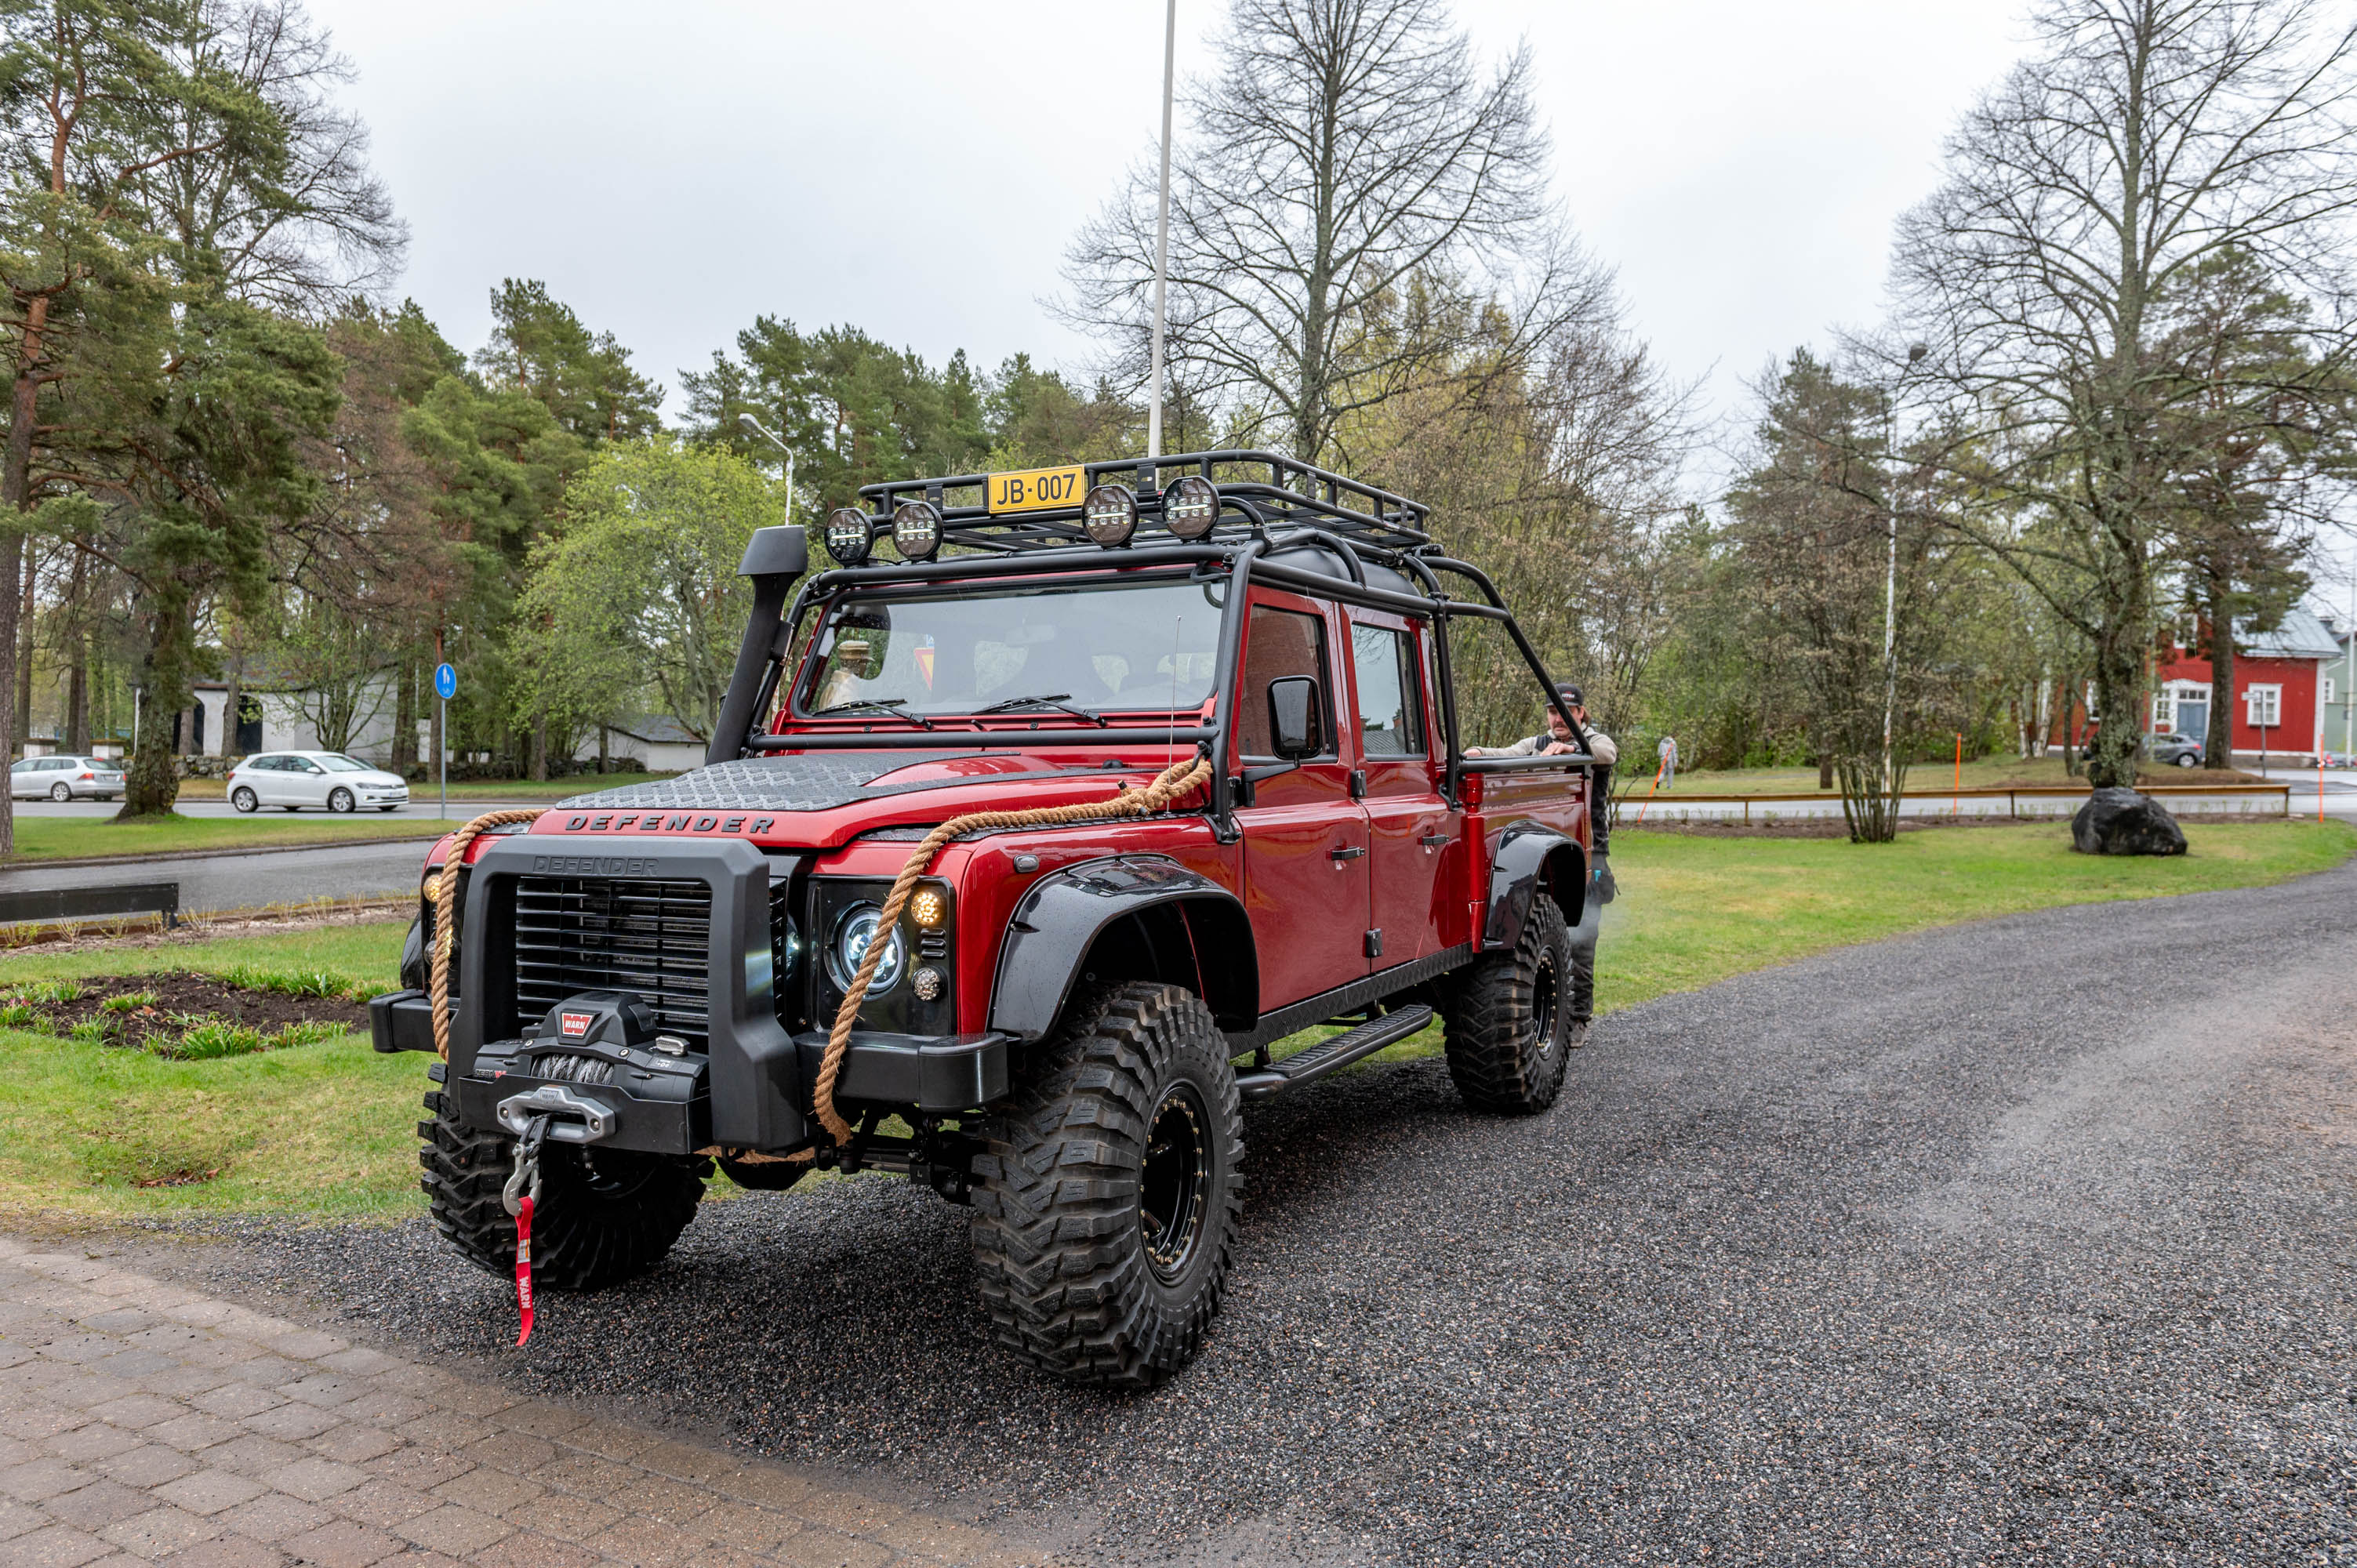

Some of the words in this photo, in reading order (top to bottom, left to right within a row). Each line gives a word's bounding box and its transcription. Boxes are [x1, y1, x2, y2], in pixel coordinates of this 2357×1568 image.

[565, 815, 775, 833] DEFENDER
[533, 856, 659, 877] DEFENDER
[565, 1019, 586, 1029] WARN
[519, 1276, 531, 1308] WARN
